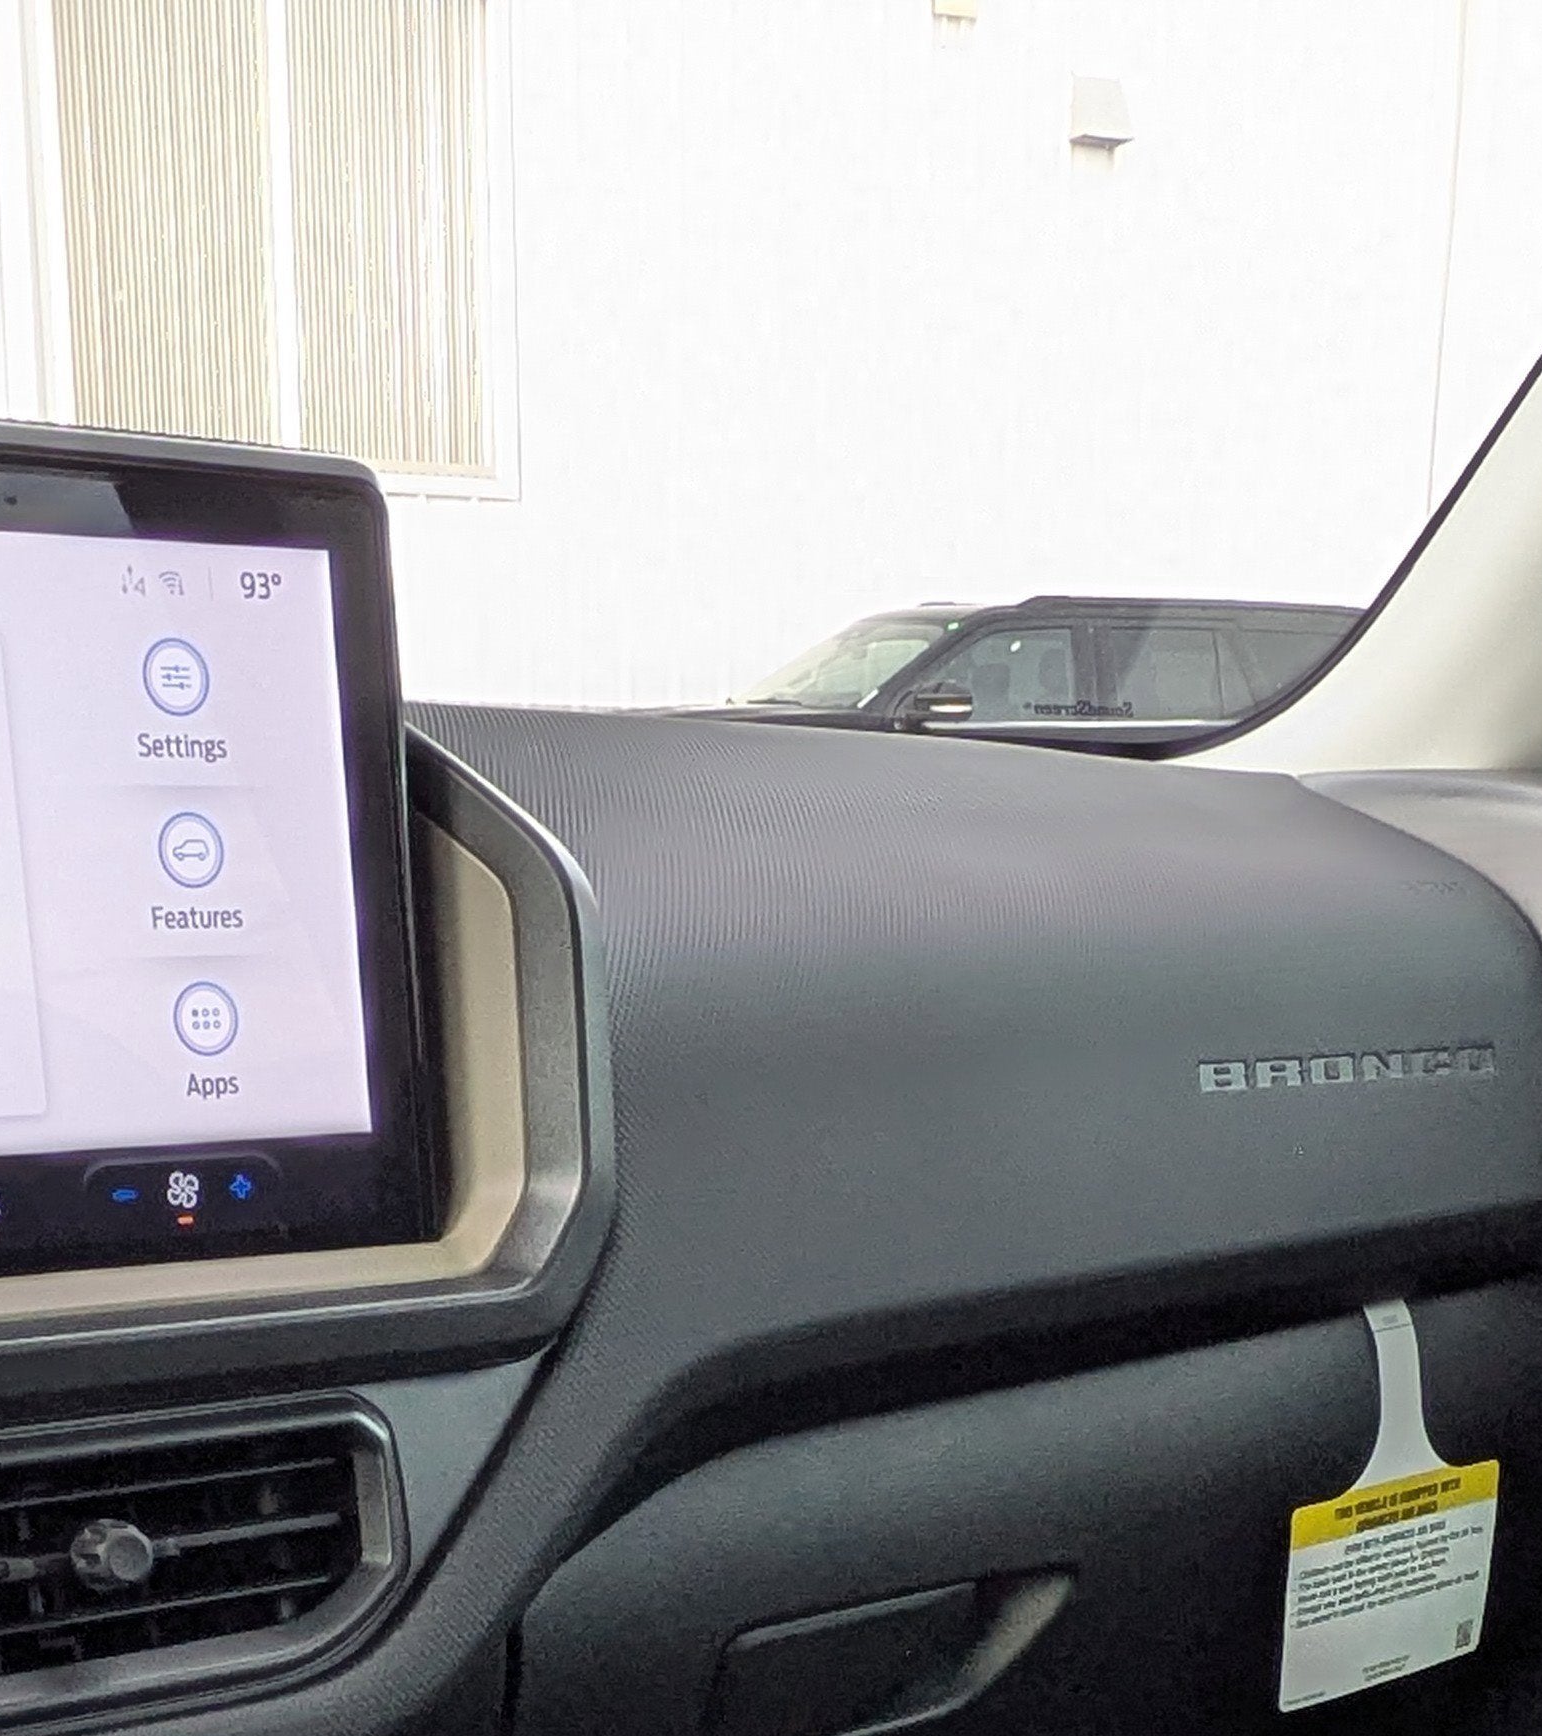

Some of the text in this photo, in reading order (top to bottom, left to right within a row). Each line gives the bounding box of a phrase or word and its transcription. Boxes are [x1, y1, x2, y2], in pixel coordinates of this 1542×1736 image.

[239, 571, 282, 600] 93°
[137, 733, 227, 763] Settings
[151, 906, 243, 929] Features
[1197, 1045, 1496, 1093] BRONCO
[187, 1073, 239, 1100] Apps
